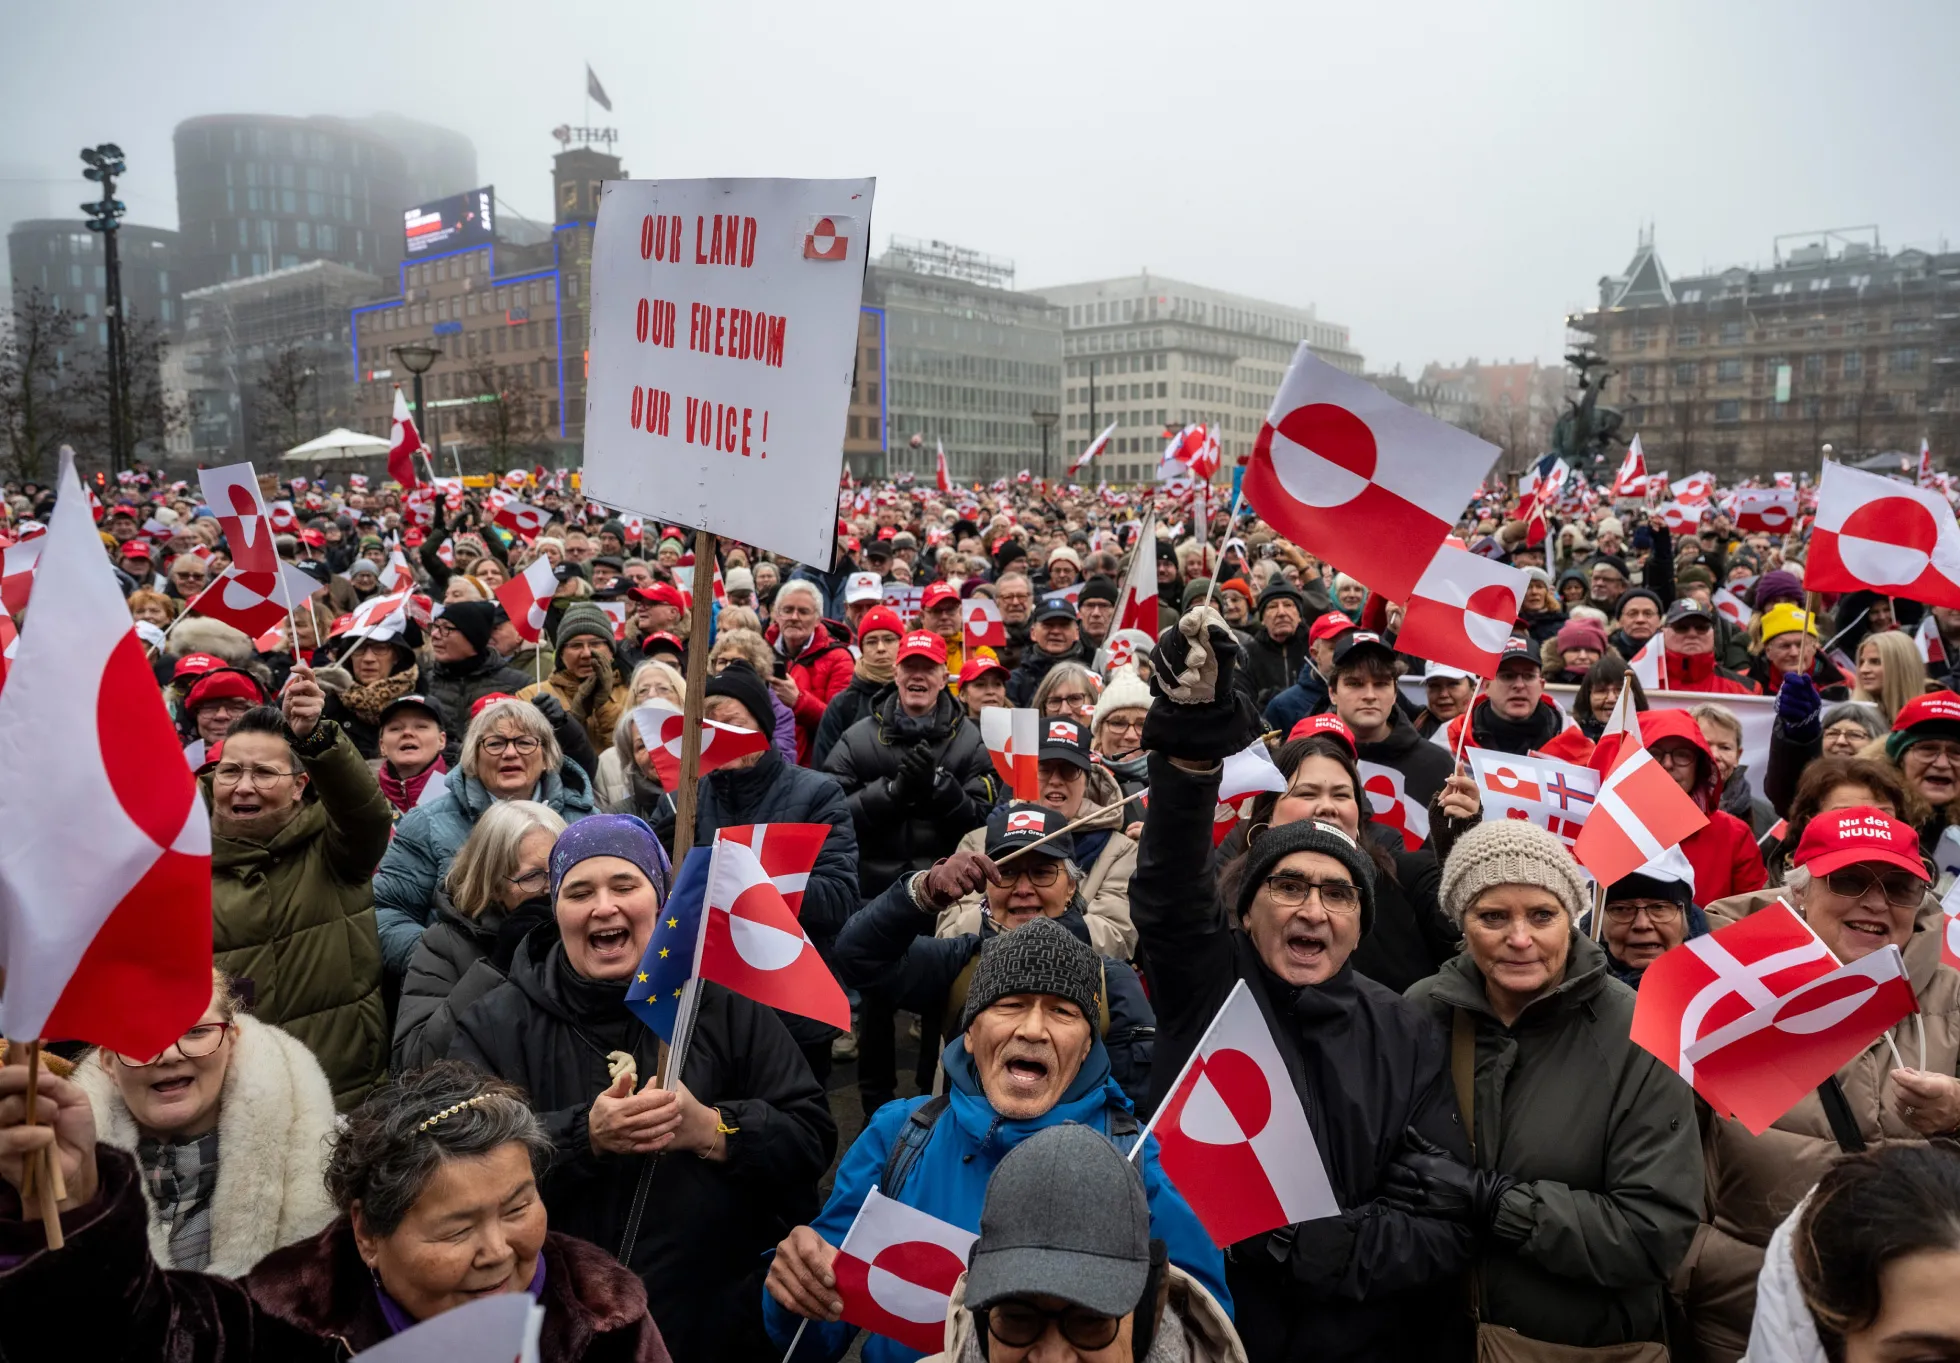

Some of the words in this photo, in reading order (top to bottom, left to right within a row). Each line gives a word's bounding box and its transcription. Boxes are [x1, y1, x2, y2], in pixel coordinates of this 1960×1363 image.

[572, 127, 618, 142] THAI
[641, 214, 682, 263] OUR
[696, 214, 757, 268] LAND
[636, 298, 676, 348] OUR
[690, 302, 787, 368] FREEDOM
[631, 385, 671, 437] OUR
[686, 396, 769, 459] VOICE!
[1838, 819, 1860, 828] Nu
[1864, 815, 1890, 828] det
[1003, 829, 1027, 837] Already
[1839, 827, 1892, 840] NUUK!
